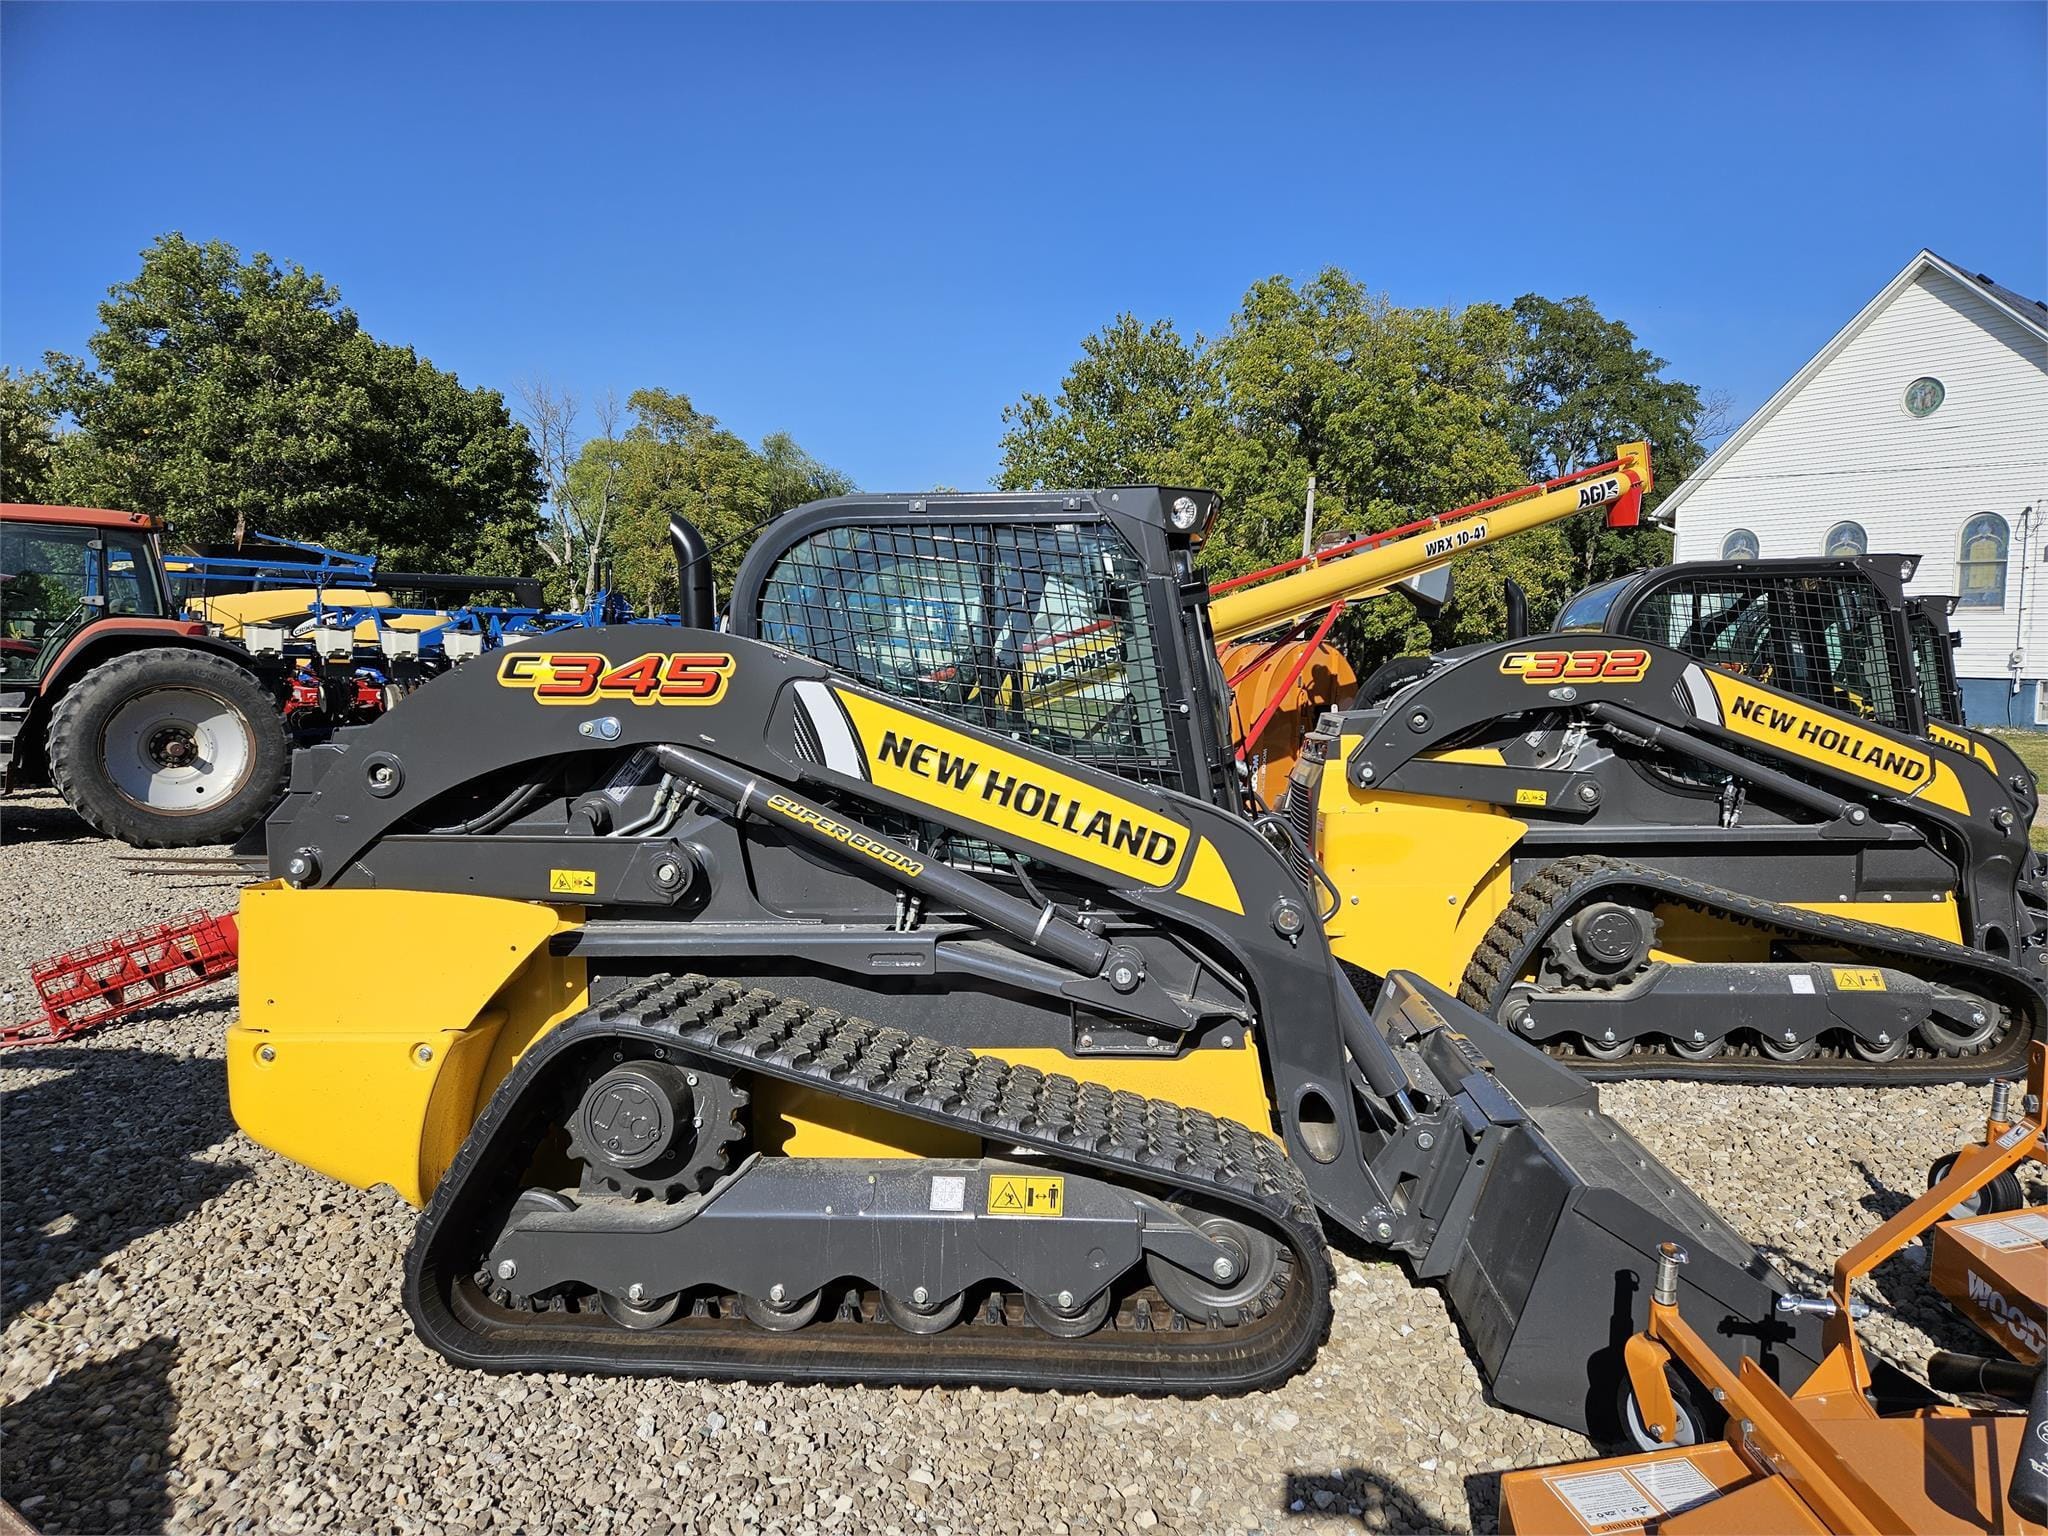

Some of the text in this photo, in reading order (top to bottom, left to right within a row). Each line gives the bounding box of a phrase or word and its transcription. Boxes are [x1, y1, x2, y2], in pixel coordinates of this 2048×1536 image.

[1578, 483, 1606, 508] AGI
[1425, 525, 1487, 557] WRX 10-41
[500, 654, 733, 702] C345
[1501, 651, 1649, 681] C332
[1731, 696, 1925, 781] NEW HOLLAND
[878, 730, 979, 791] NEW
[981, 769, 1177, 866] HOLLAND
[769, 795, 922, 875] SUPER BOOM
